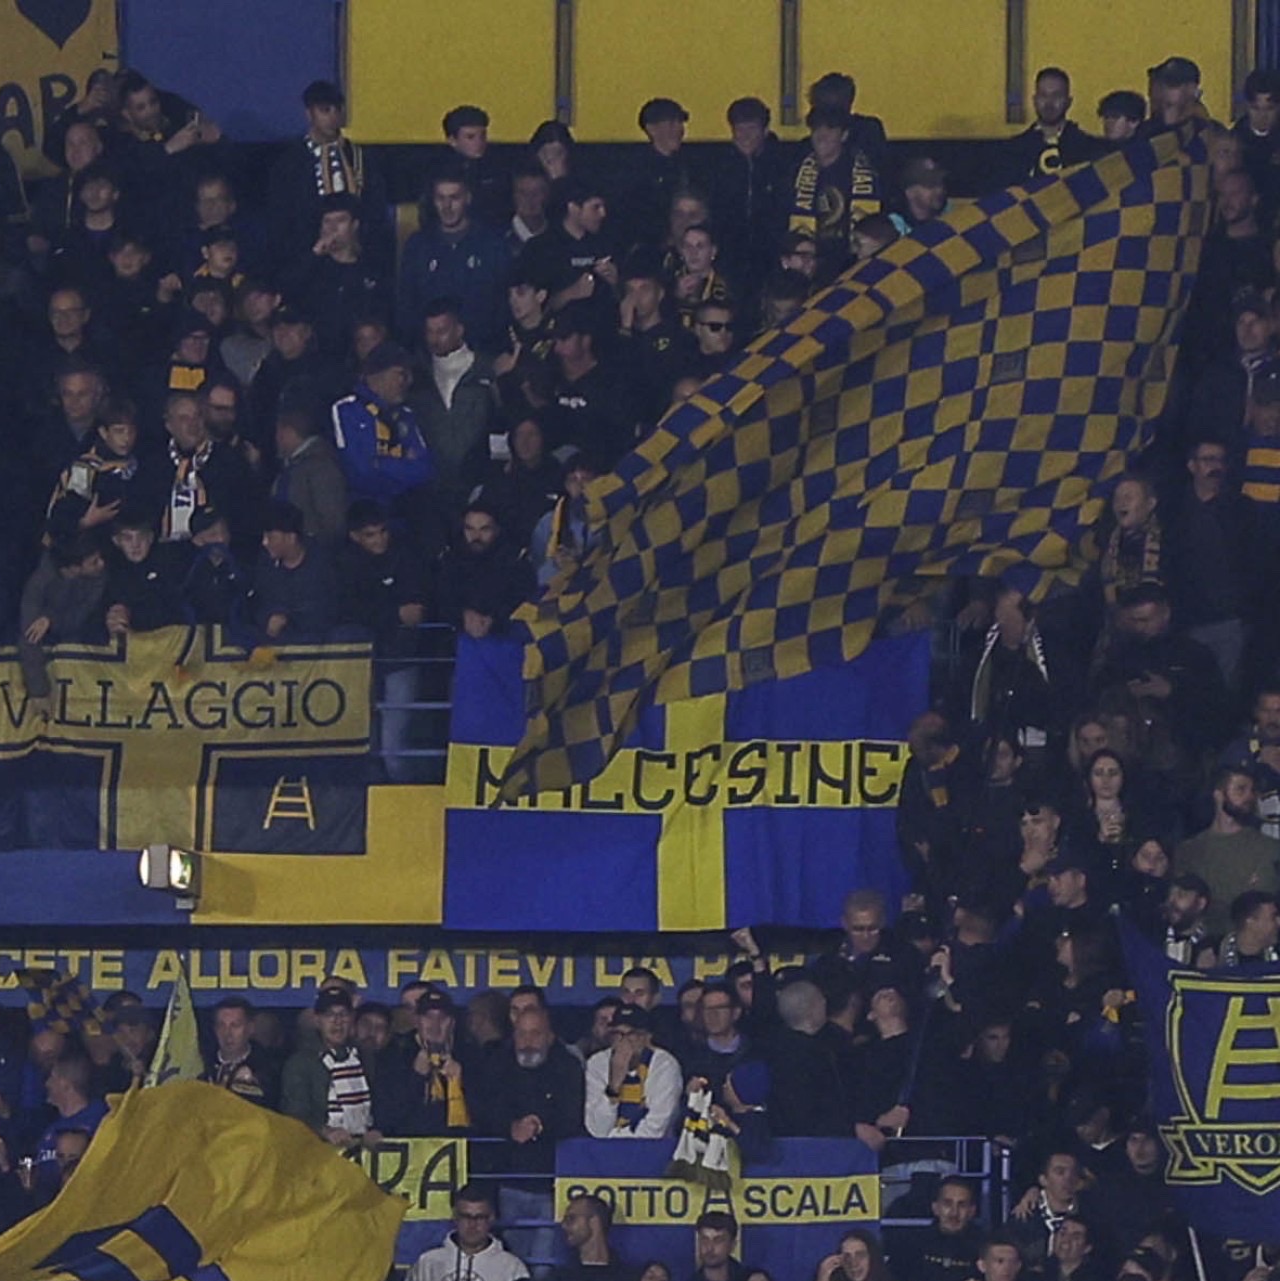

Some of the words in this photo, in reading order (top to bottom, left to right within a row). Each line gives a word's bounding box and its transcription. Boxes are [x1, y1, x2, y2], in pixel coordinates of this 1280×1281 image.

[0, 678, 346, 730] VLLAGGIO
[475, 742, 899, 810] MLCESINE
[146, 949, 367, 989] ALLORA
[386, 949, 574, 989] FATEVI
[1194, 1131, 1280, 1157] VERO
[743, 1181, 869, 1219] SCALA
